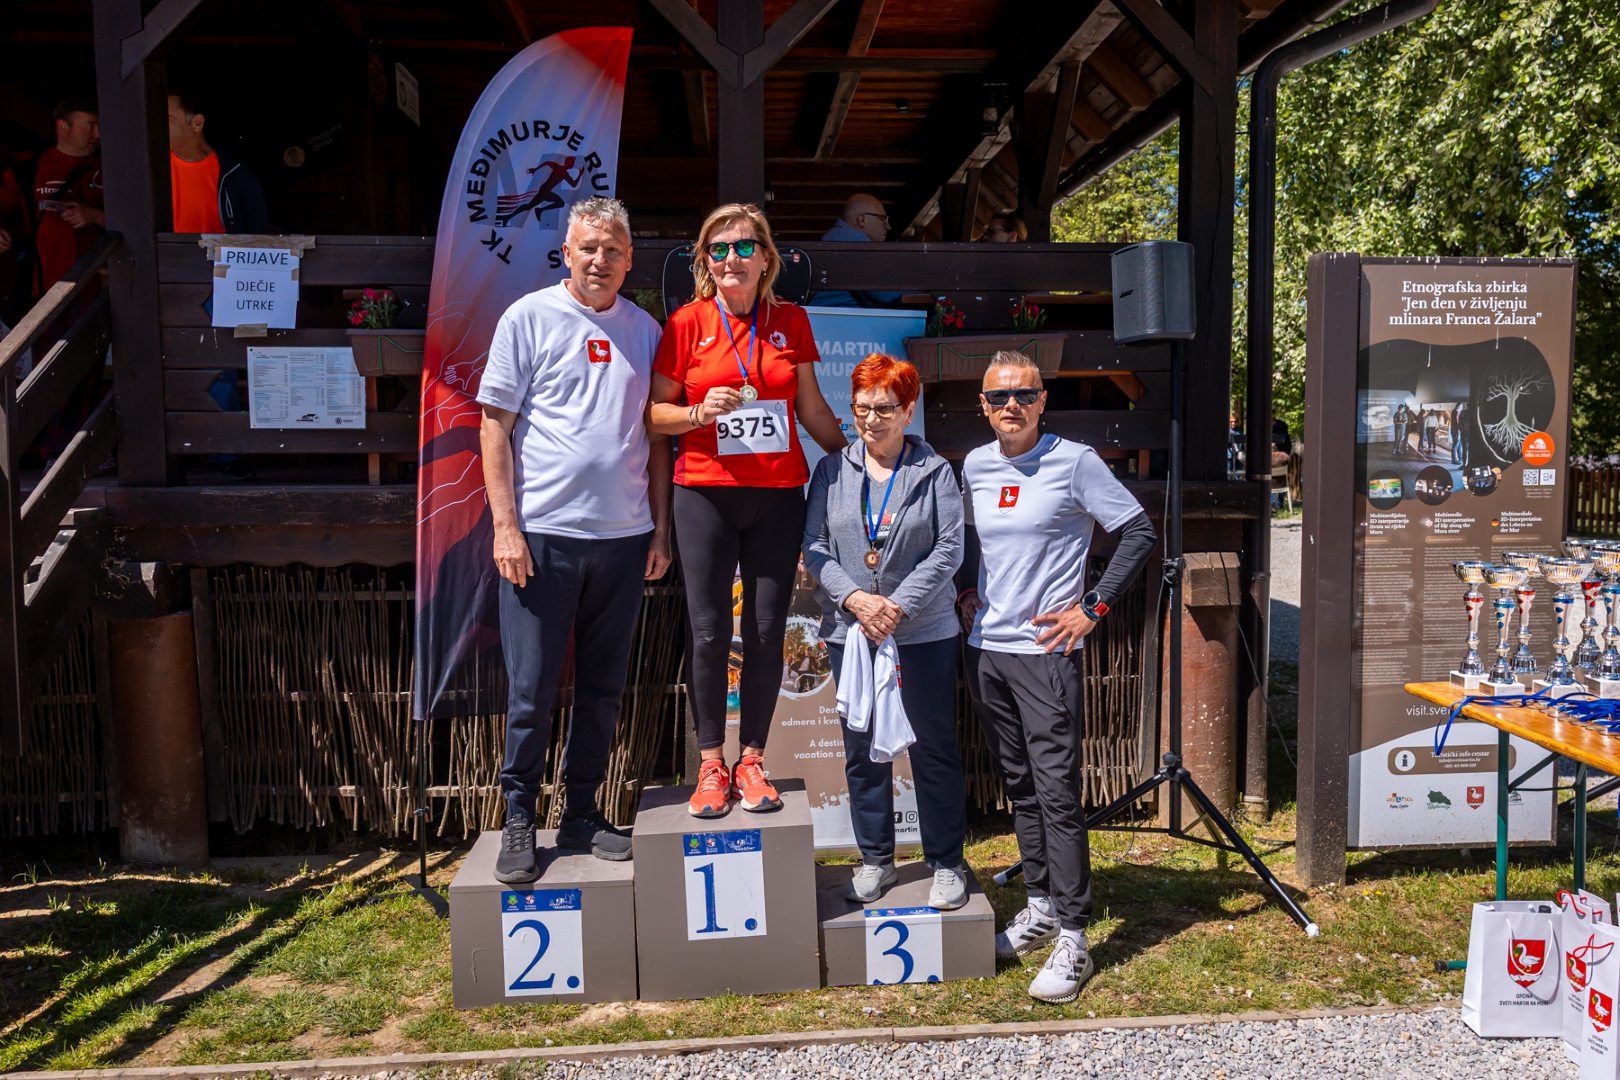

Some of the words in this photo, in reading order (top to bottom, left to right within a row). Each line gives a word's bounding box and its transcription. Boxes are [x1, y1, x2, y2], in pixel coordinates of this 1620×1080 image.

[467, 120, 584, 223] MEĐIMURJE
[480, 229, 512, 265] TK
[226, 250, 289, 266] PRIJAVE
[236, 280, 276, 293] DJEČJE
[1402, 280, 1482, 296] Etnografska
[1485, 280, 1528, 293] zbirka
[236, 299, 275, 311] UTRKE
[1430, 297, 1456, 309] den
[1459, 300, 1467, 309] v
[1470, 296, 1528, 312] življenju
[1388, 312, 1442, 325] mlinara
[1445, 312, 1491, 325] Franca
[717, 416, 776, 439] 9375
[781, 717, 816, 726] odmora
[809, 739, 816, 748] A
[794, 750, 833, 759] vacation
[692, 862, 758, 933] 1.
[508, 919, 580, 991] 2.
